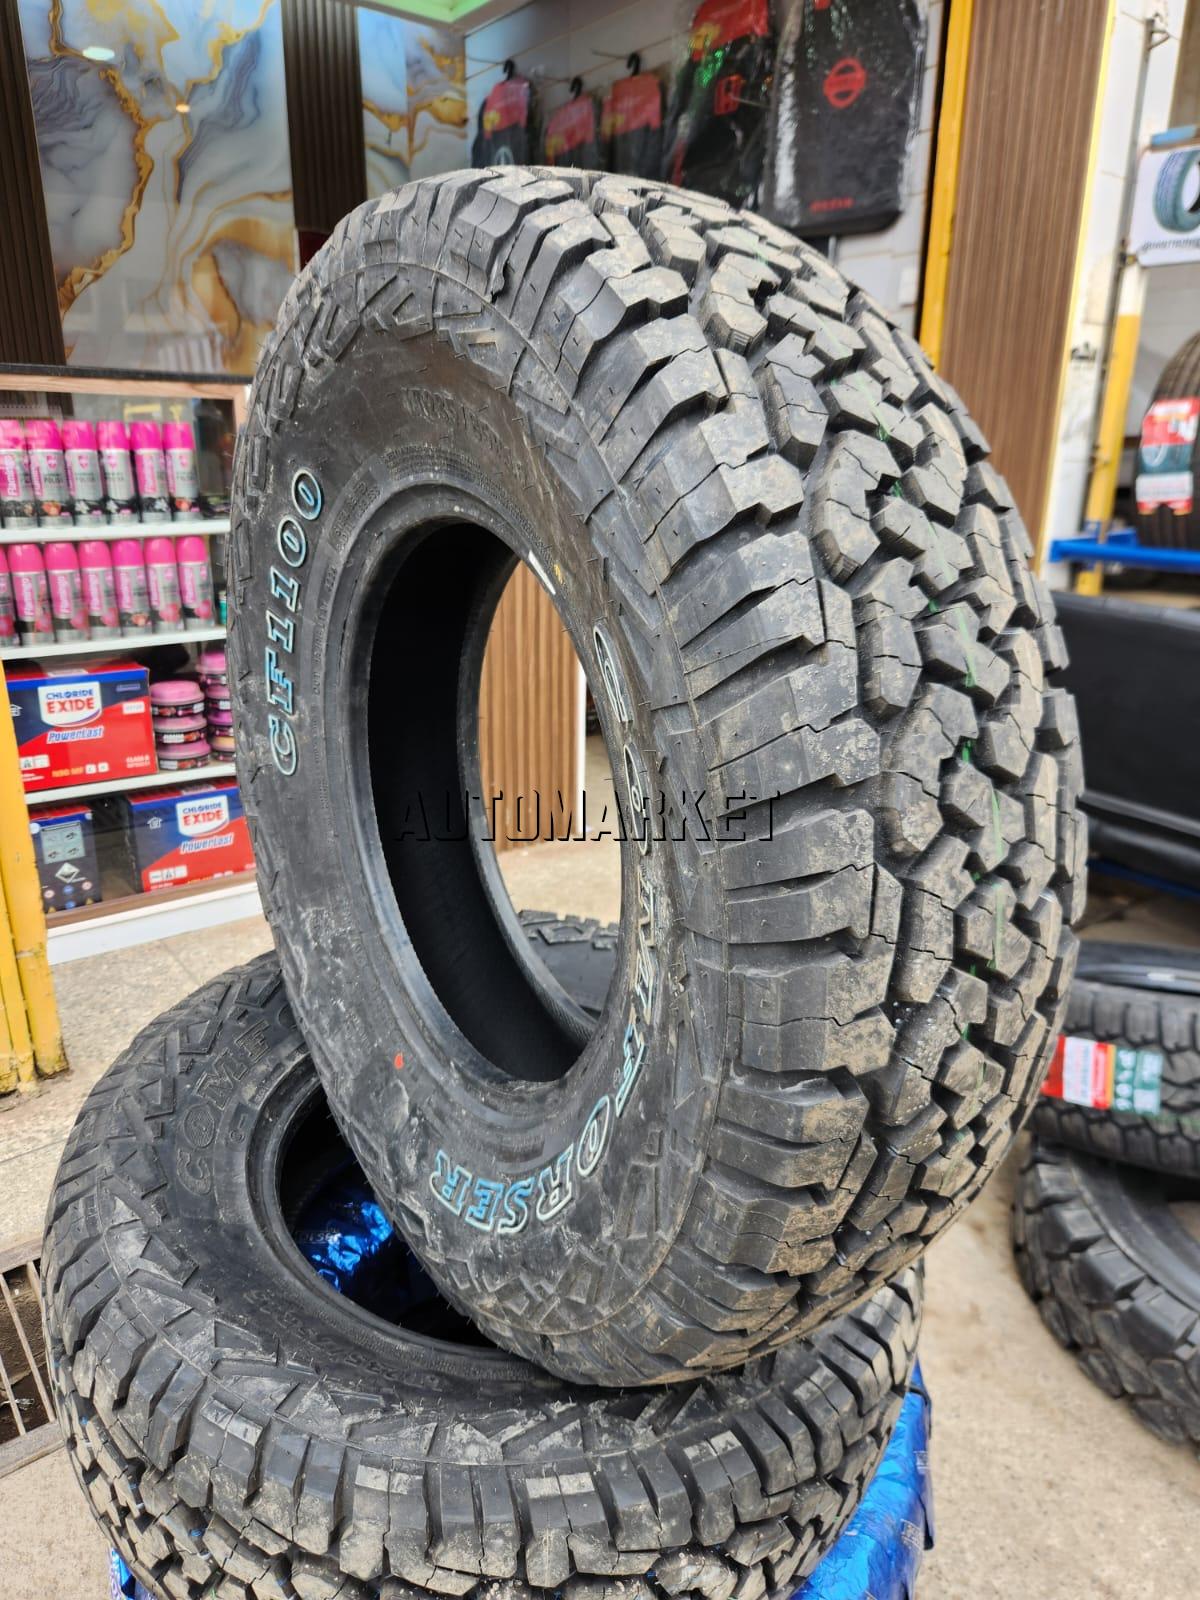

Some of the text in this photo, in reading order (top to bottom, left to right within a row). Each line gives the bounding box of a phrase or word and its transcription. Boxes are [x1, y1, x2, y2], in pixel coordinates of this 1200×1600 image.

[265, 467, 322, 776] CF1100
[46, 689, 93, 700] CHLORIDE
[47, 697, 95, 714] EXIDE
[183, 809, 224, 826] EXIDE
